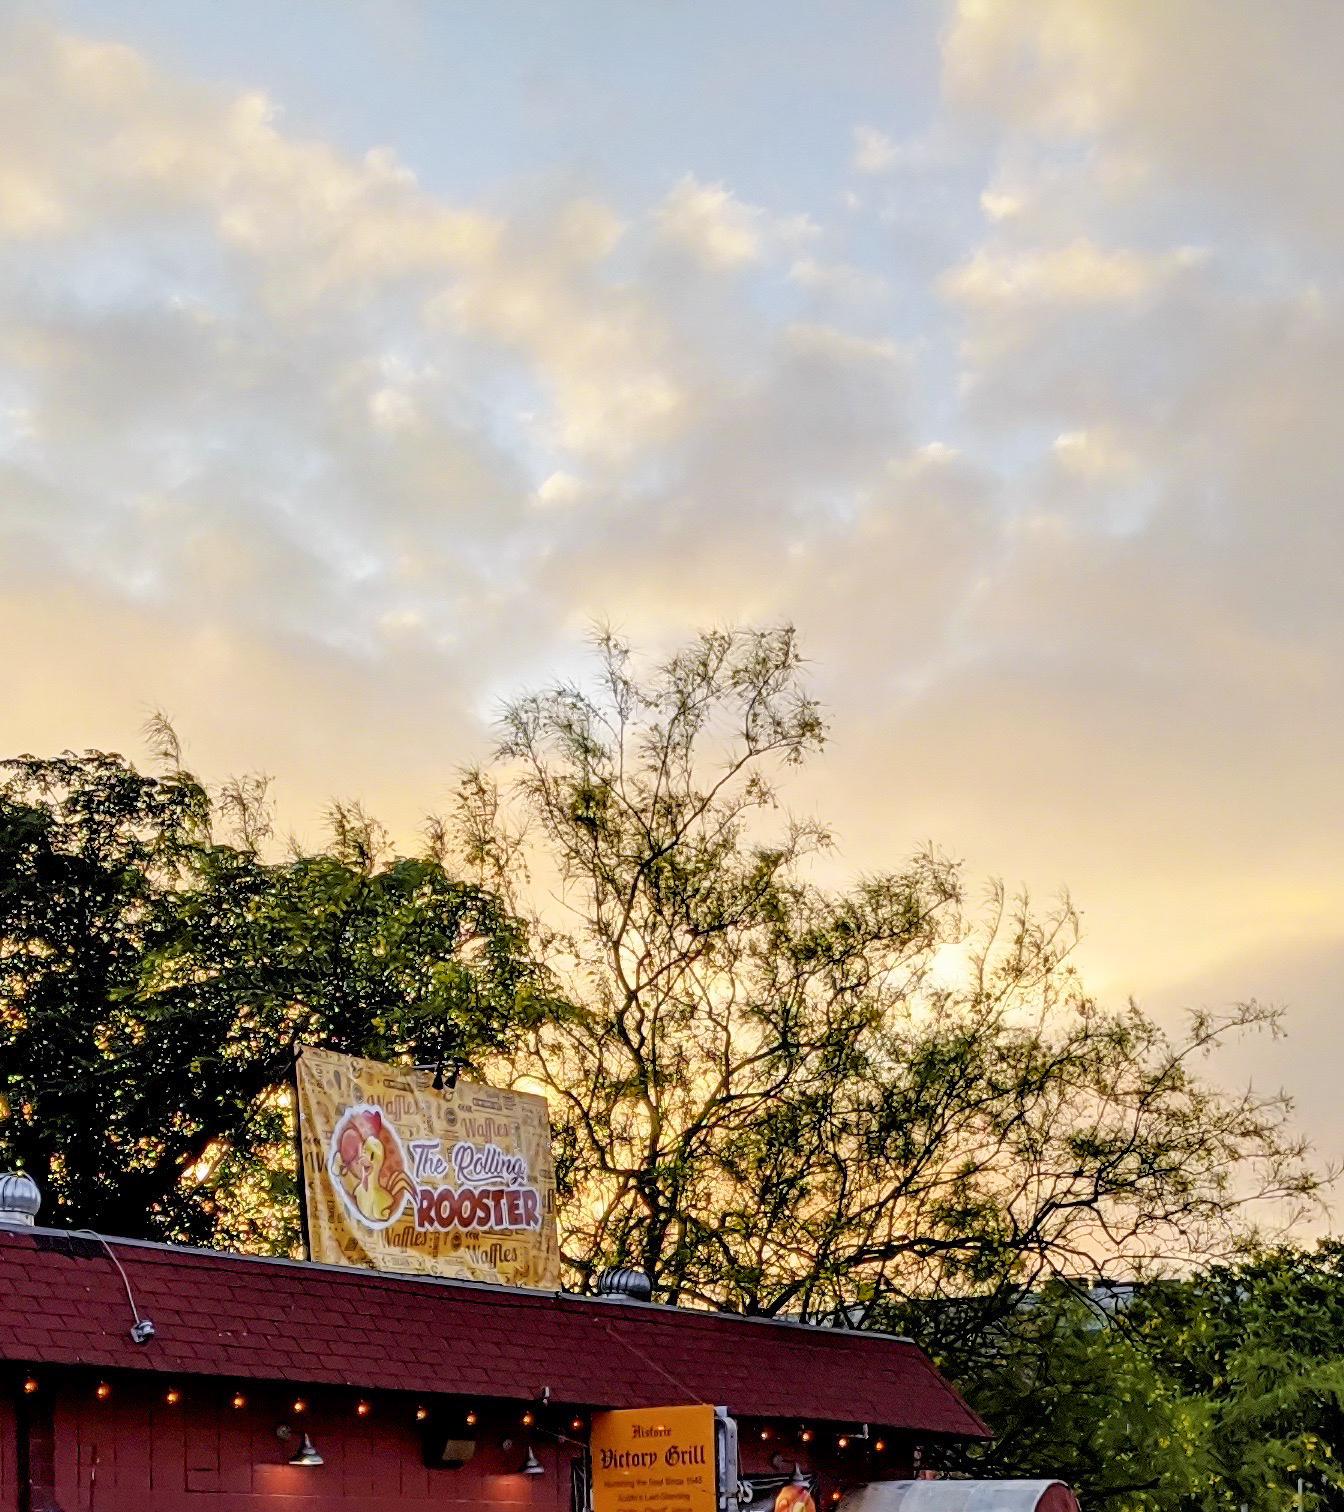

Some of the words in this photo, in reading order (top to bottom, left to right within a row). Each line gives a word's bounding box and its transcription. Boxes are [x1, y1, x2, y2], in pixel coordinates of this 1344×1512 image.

[412, 1142, 447, 1179] The
[454, 1144, 525, 1186] Rolling
[417, 1187, 540, 1228] ROOSTER
[465, 1243, 517, 1270] Waffles
[600, 1447, 657, 1469] Victory
[664, 1445, 706, 1467] Grill
